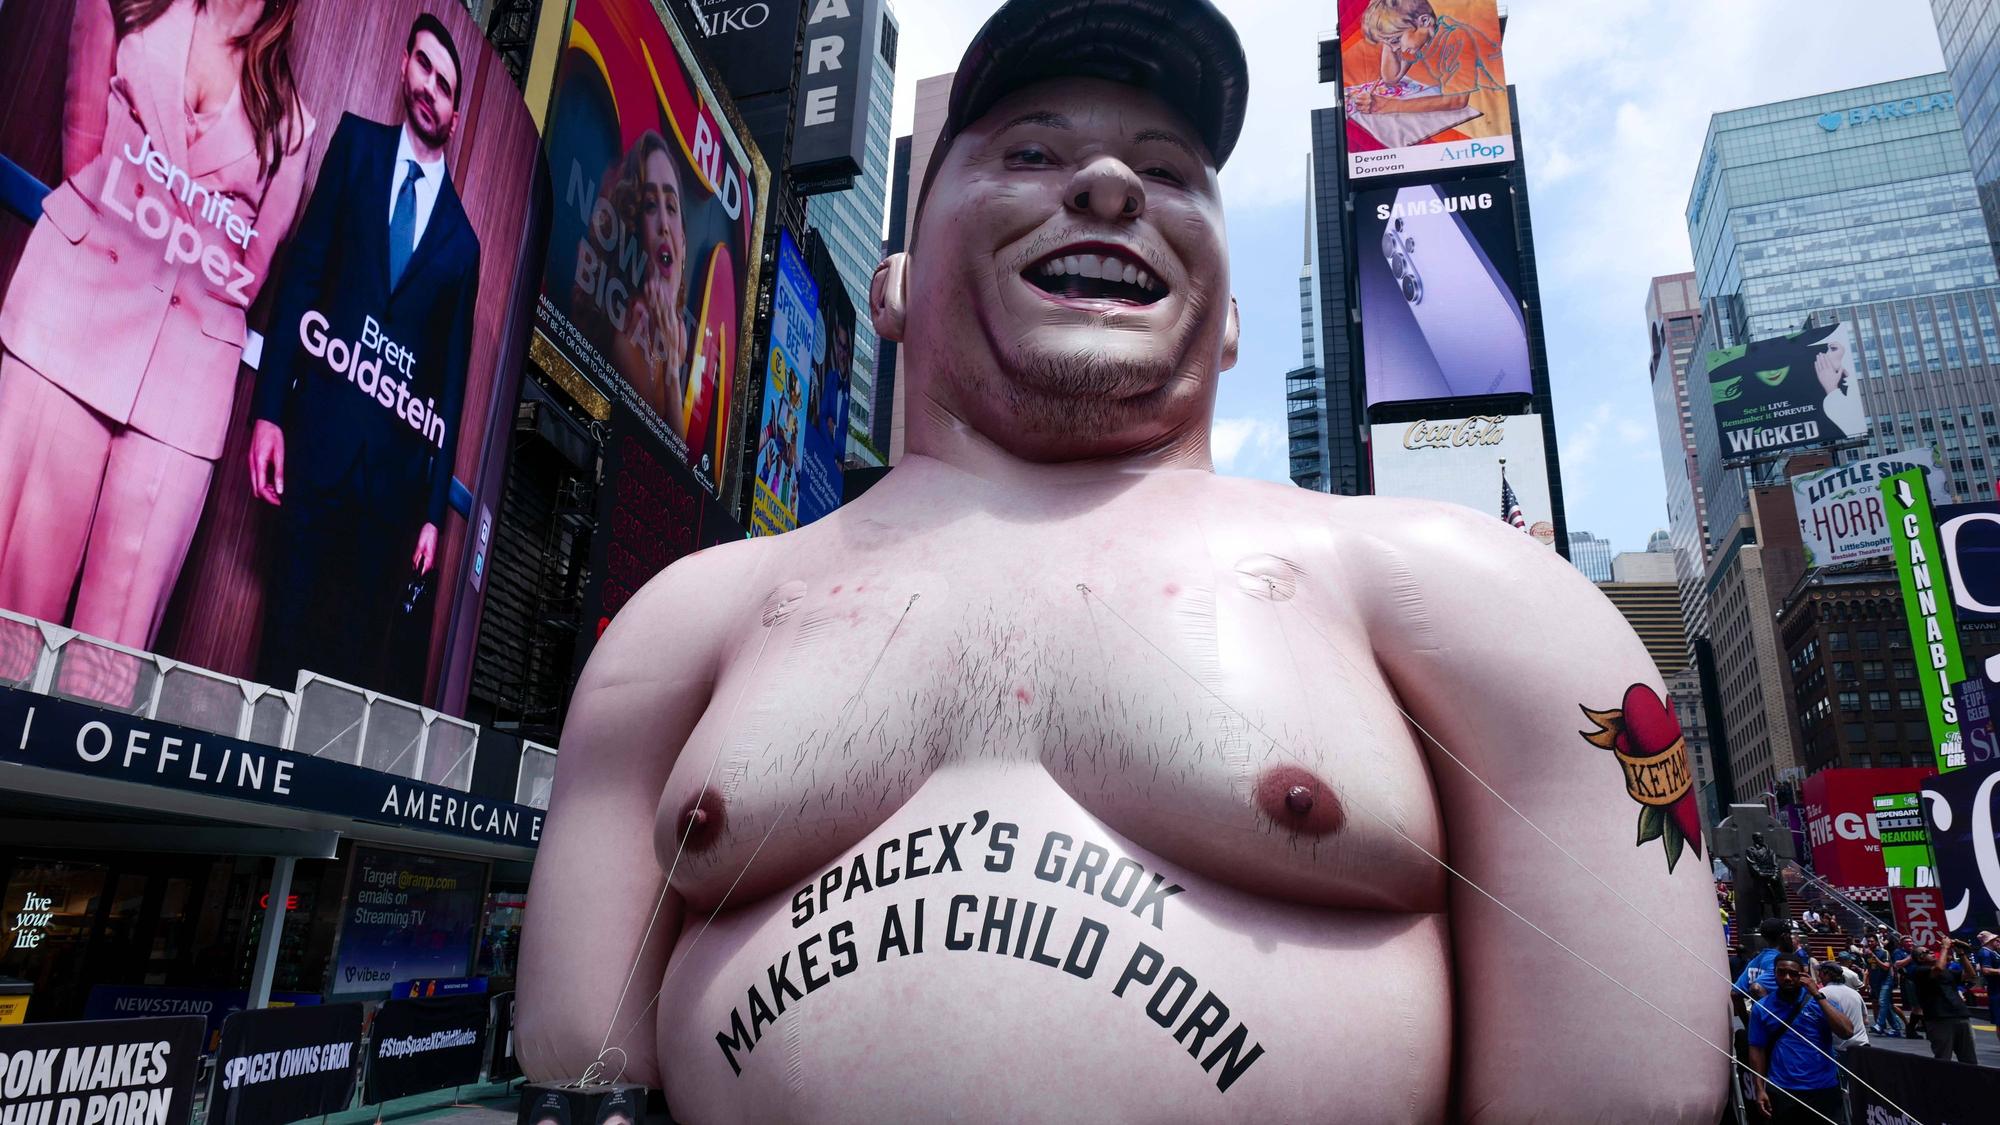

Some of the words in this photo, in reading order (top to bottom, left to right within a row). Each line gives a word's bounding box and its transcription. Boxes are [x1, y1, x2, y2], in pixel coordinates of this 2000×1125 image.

[704, 3, 769, 36] IKO
[1355, 152, 1397, 164] Devann
[1355, 162, 1405, 175] Donovan
[1440, 142, 1505, 162] ArtPop
[124, 134, 259, 250] Jennifer
[1376, 193, 1493, 220] SAMSUNG
[100, 157, 256, 306] Lopez
[566, 157, 648, 288] NOW
[575, 236, 629, 332] BIG
[778, 285, 811, 352] SPELLING
[361, 314, 416, 381] Brett
[786, 324, 800, 362] BEE
[300, 310, 446, 449] Goldstein
[1722, 414, 1764, 428] Remember
[1743, 406, 1758, 415] See
[1808, 464, 1874, 504] LITTLE
[1812, 497, 1884, 553] HORR
[1903, 513, 1958, 723] CANNABIS
[76, 721, 294, 796] OFFLINE
[381, 785, 519, 837] AMERICAN
[1809, 814, 1834, 847] FIVE
[362, 867, 397, 888] Target
[398, 871, 456, 891] @ramp.com
[791, 810, 1019, 929] SPACEX'S
[1033, 830, 1185, 930] GROK
[23, 892, 51, 911] live
[358, 888, 393, 905] emails
[395, 893, 408, 905] on
[11, 912, 53, 931] your
[355, 907, 412, 928] Streaming
[411, 910, 426, 925] TV
[356, 967, 390, 982] vibe.co
[114, 997, 213, 1013] NEWSSTAND
[715, 919, 859, 1077] MAKES
[876, 898, 925, 963] AI
[945, 894, 1110, 980] CHILD
[1111, 942, 1265, 1094] PORN
[57, 1041, 170, 1094] MAKES
[279, 1045, 321, 1076] OWNS
[319, 1042, 354, 1071] GROK
[84, 1087, 174, 1125] PORN
